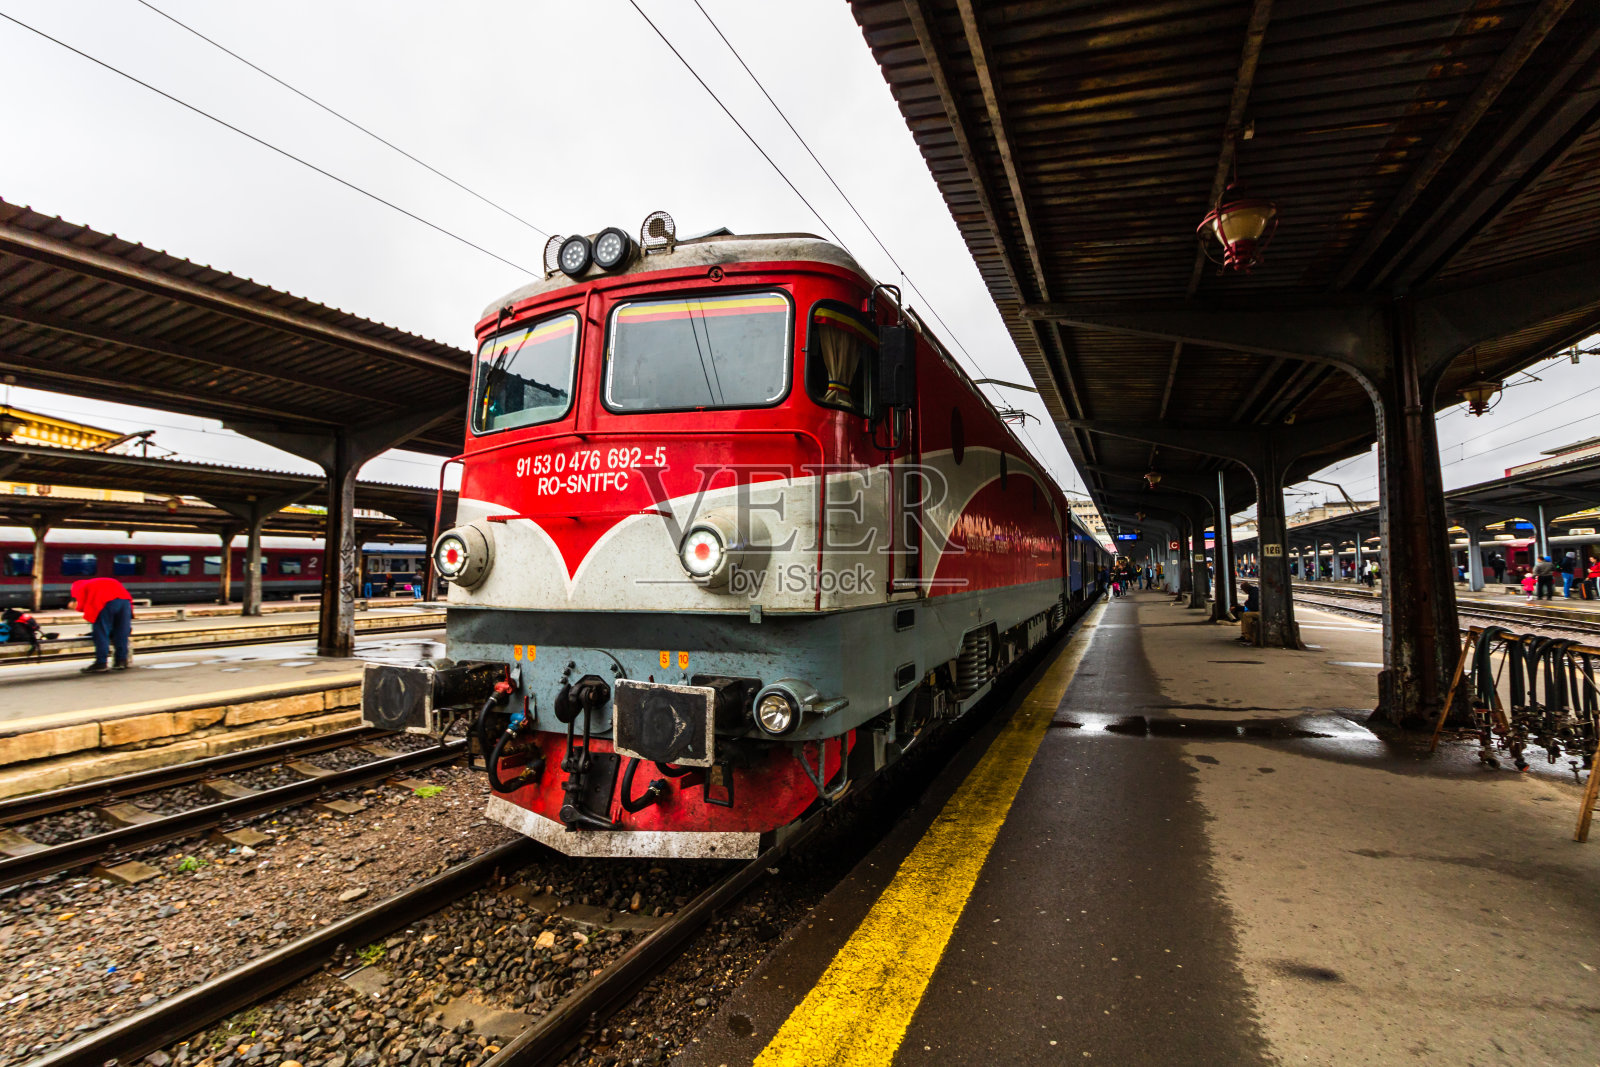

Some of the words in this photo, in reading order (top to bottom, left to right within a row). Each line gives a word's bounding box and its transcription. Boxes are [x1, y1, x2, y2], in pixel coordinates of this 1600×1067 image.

[516, 457, 531, 477] 91
[533, 454, 551, 475] 53
[554, 452, 566, 473] 0
[568, 450, 600, 471] 476
[607, 446, 666, 469] 692-5
[537, 471, 629, 496] RO-SNTFC
[1171, 541, 1178, 549] C
[308, 557, 318, 568] 2
[514, 647, 522, 656] 10
[529, 647, 535, 657] 5
[662, 654, 668, 663] 5
[679, 654, 689, 664] 10
